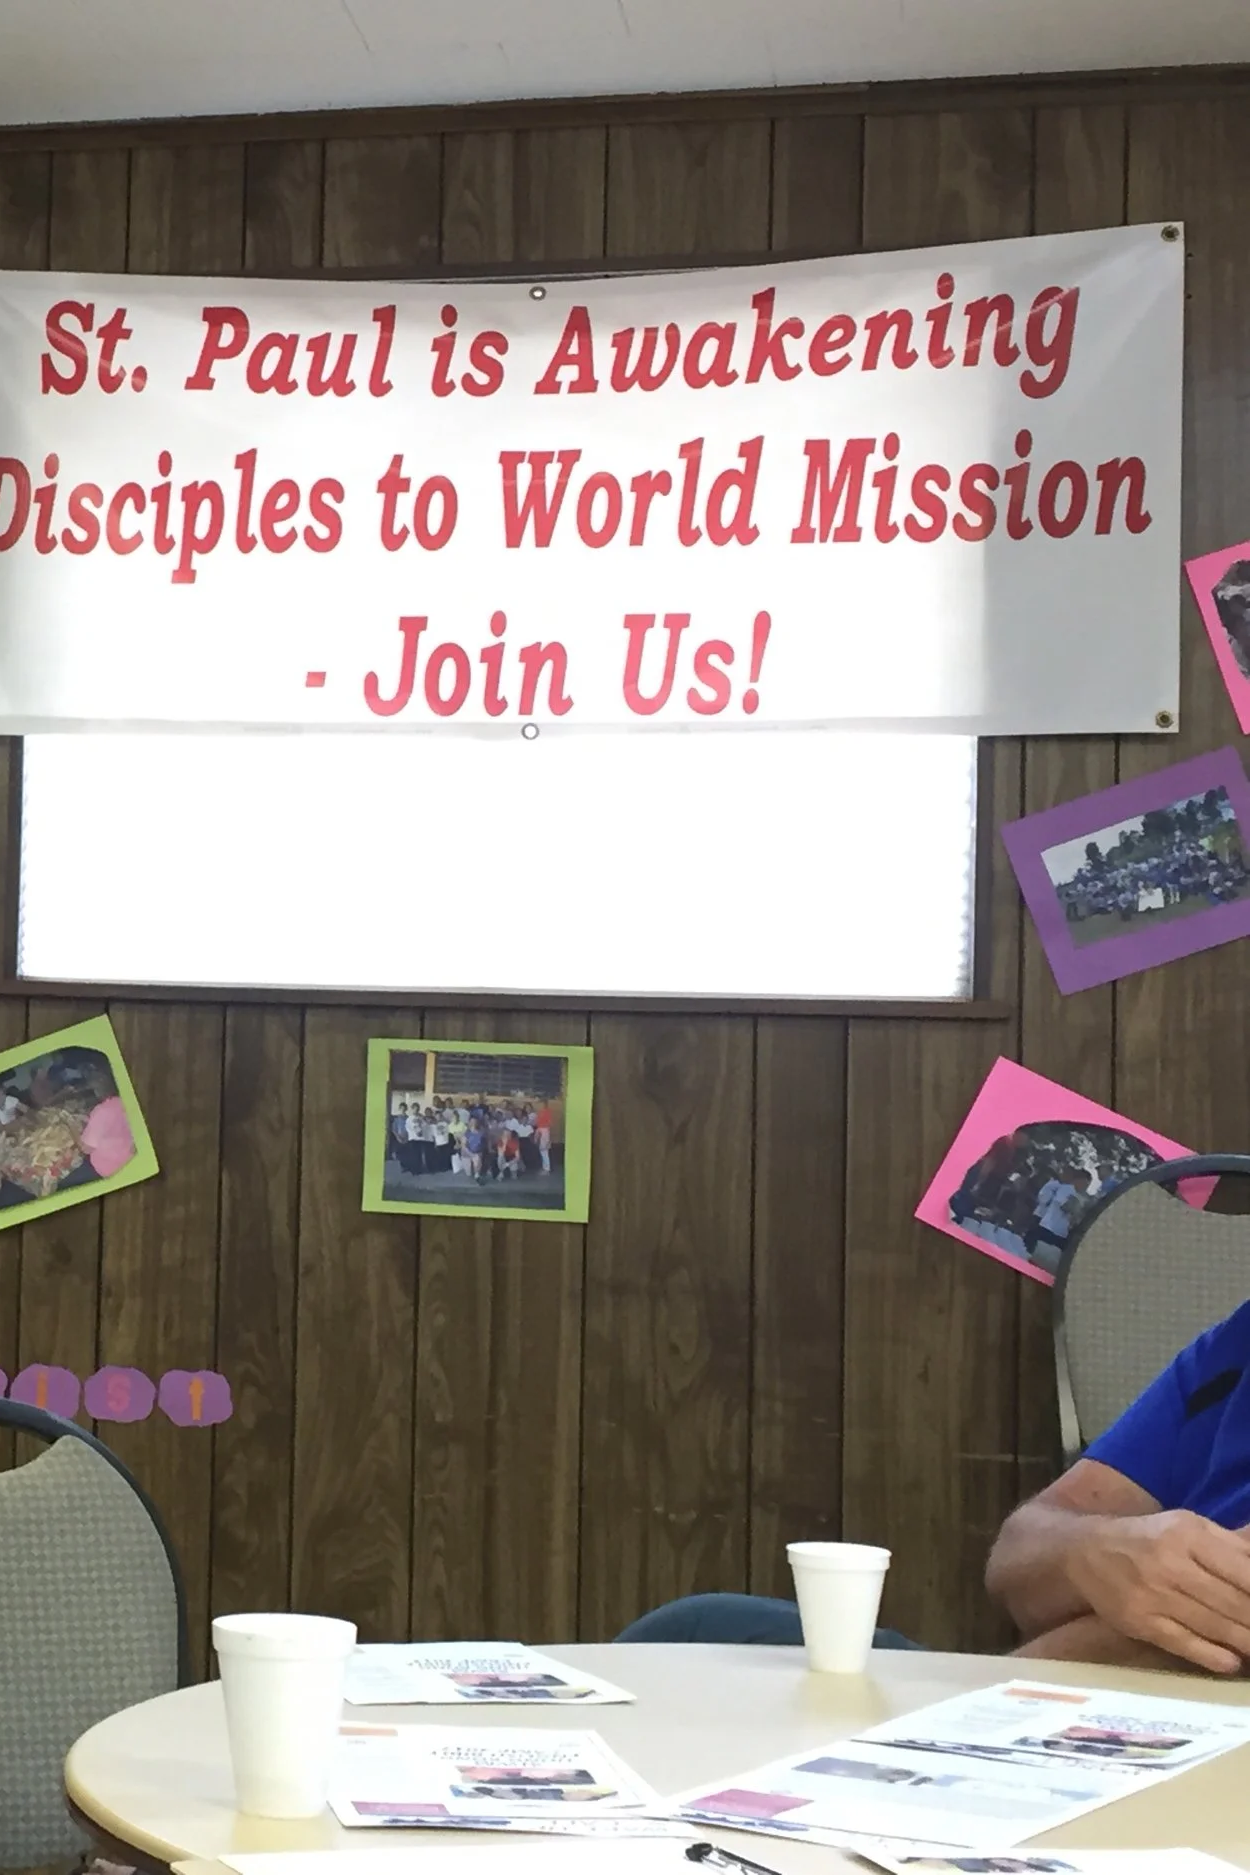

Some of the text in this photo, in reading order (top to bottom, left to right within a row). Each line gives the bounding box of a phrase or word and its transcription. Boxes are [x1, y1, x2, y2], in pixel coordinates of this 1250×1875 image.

[41, 272, 1080, 399] St. Paul is Awakening
[377, 454, 459, 551] to
[499, 435, 764, 549] World
[790, 429, 1153, 544] Mission
[364, 610, 574, 717] Join
[623, 610, 771, 715] Us!
